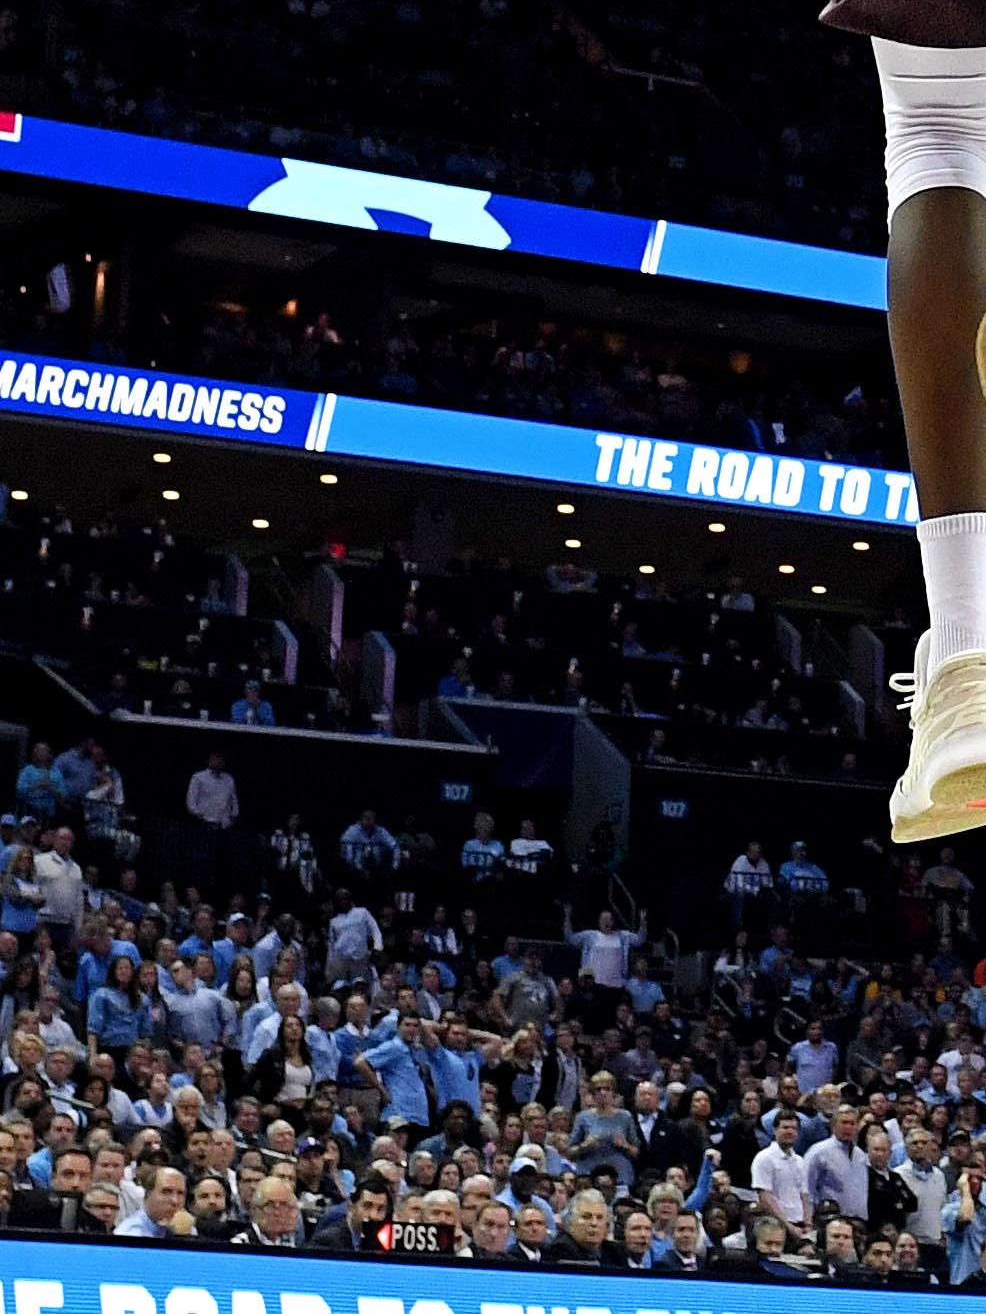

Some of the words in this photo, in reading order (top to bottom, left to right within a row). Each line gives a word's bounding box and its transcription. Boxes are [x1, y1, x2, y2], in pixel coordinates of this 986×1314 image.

[596, 434, 678, 491] THE
[687, 448, 805, 507] ROAD
[819, 465, 872, 516] TO
[391, 1223, 441, 1253] POSS.
